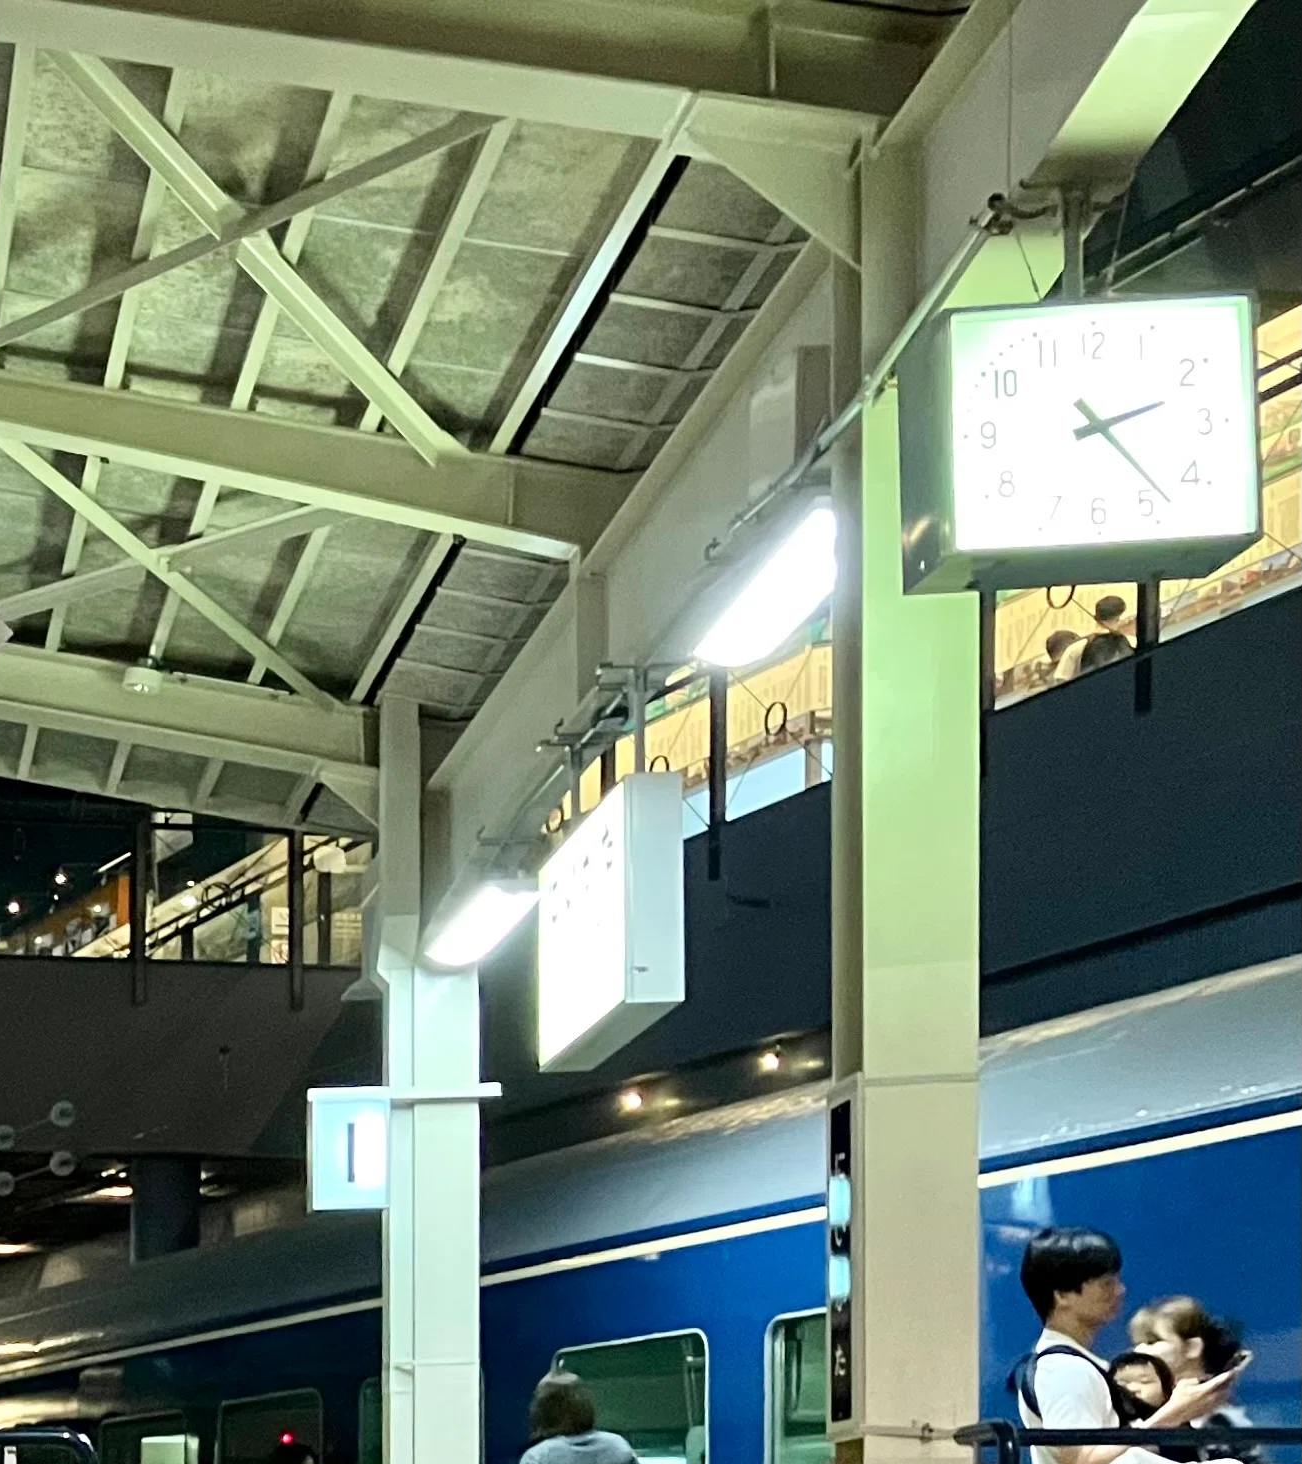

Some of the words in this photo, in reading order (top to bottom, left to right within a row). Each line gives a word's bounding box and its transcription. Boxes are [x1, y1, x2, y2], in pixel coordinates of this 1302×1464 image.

[1037, 339, 1057, 369] 11
[1081, 331, 1106, 360] 12
[994, 369, 1018, 399] 10
[1178, 358, 1196, 387] 2
[979, 421, 997, 450] 9
[1197, 408, 1214, 436] 3
[997, 470, 1016, 498] 8
[1180, 459, 1201, 486] 4
[1049, 495, 1063, 520] 7
[1090, 496, 1108, 525] 6
[1137, 489, 1154, 517] 5
